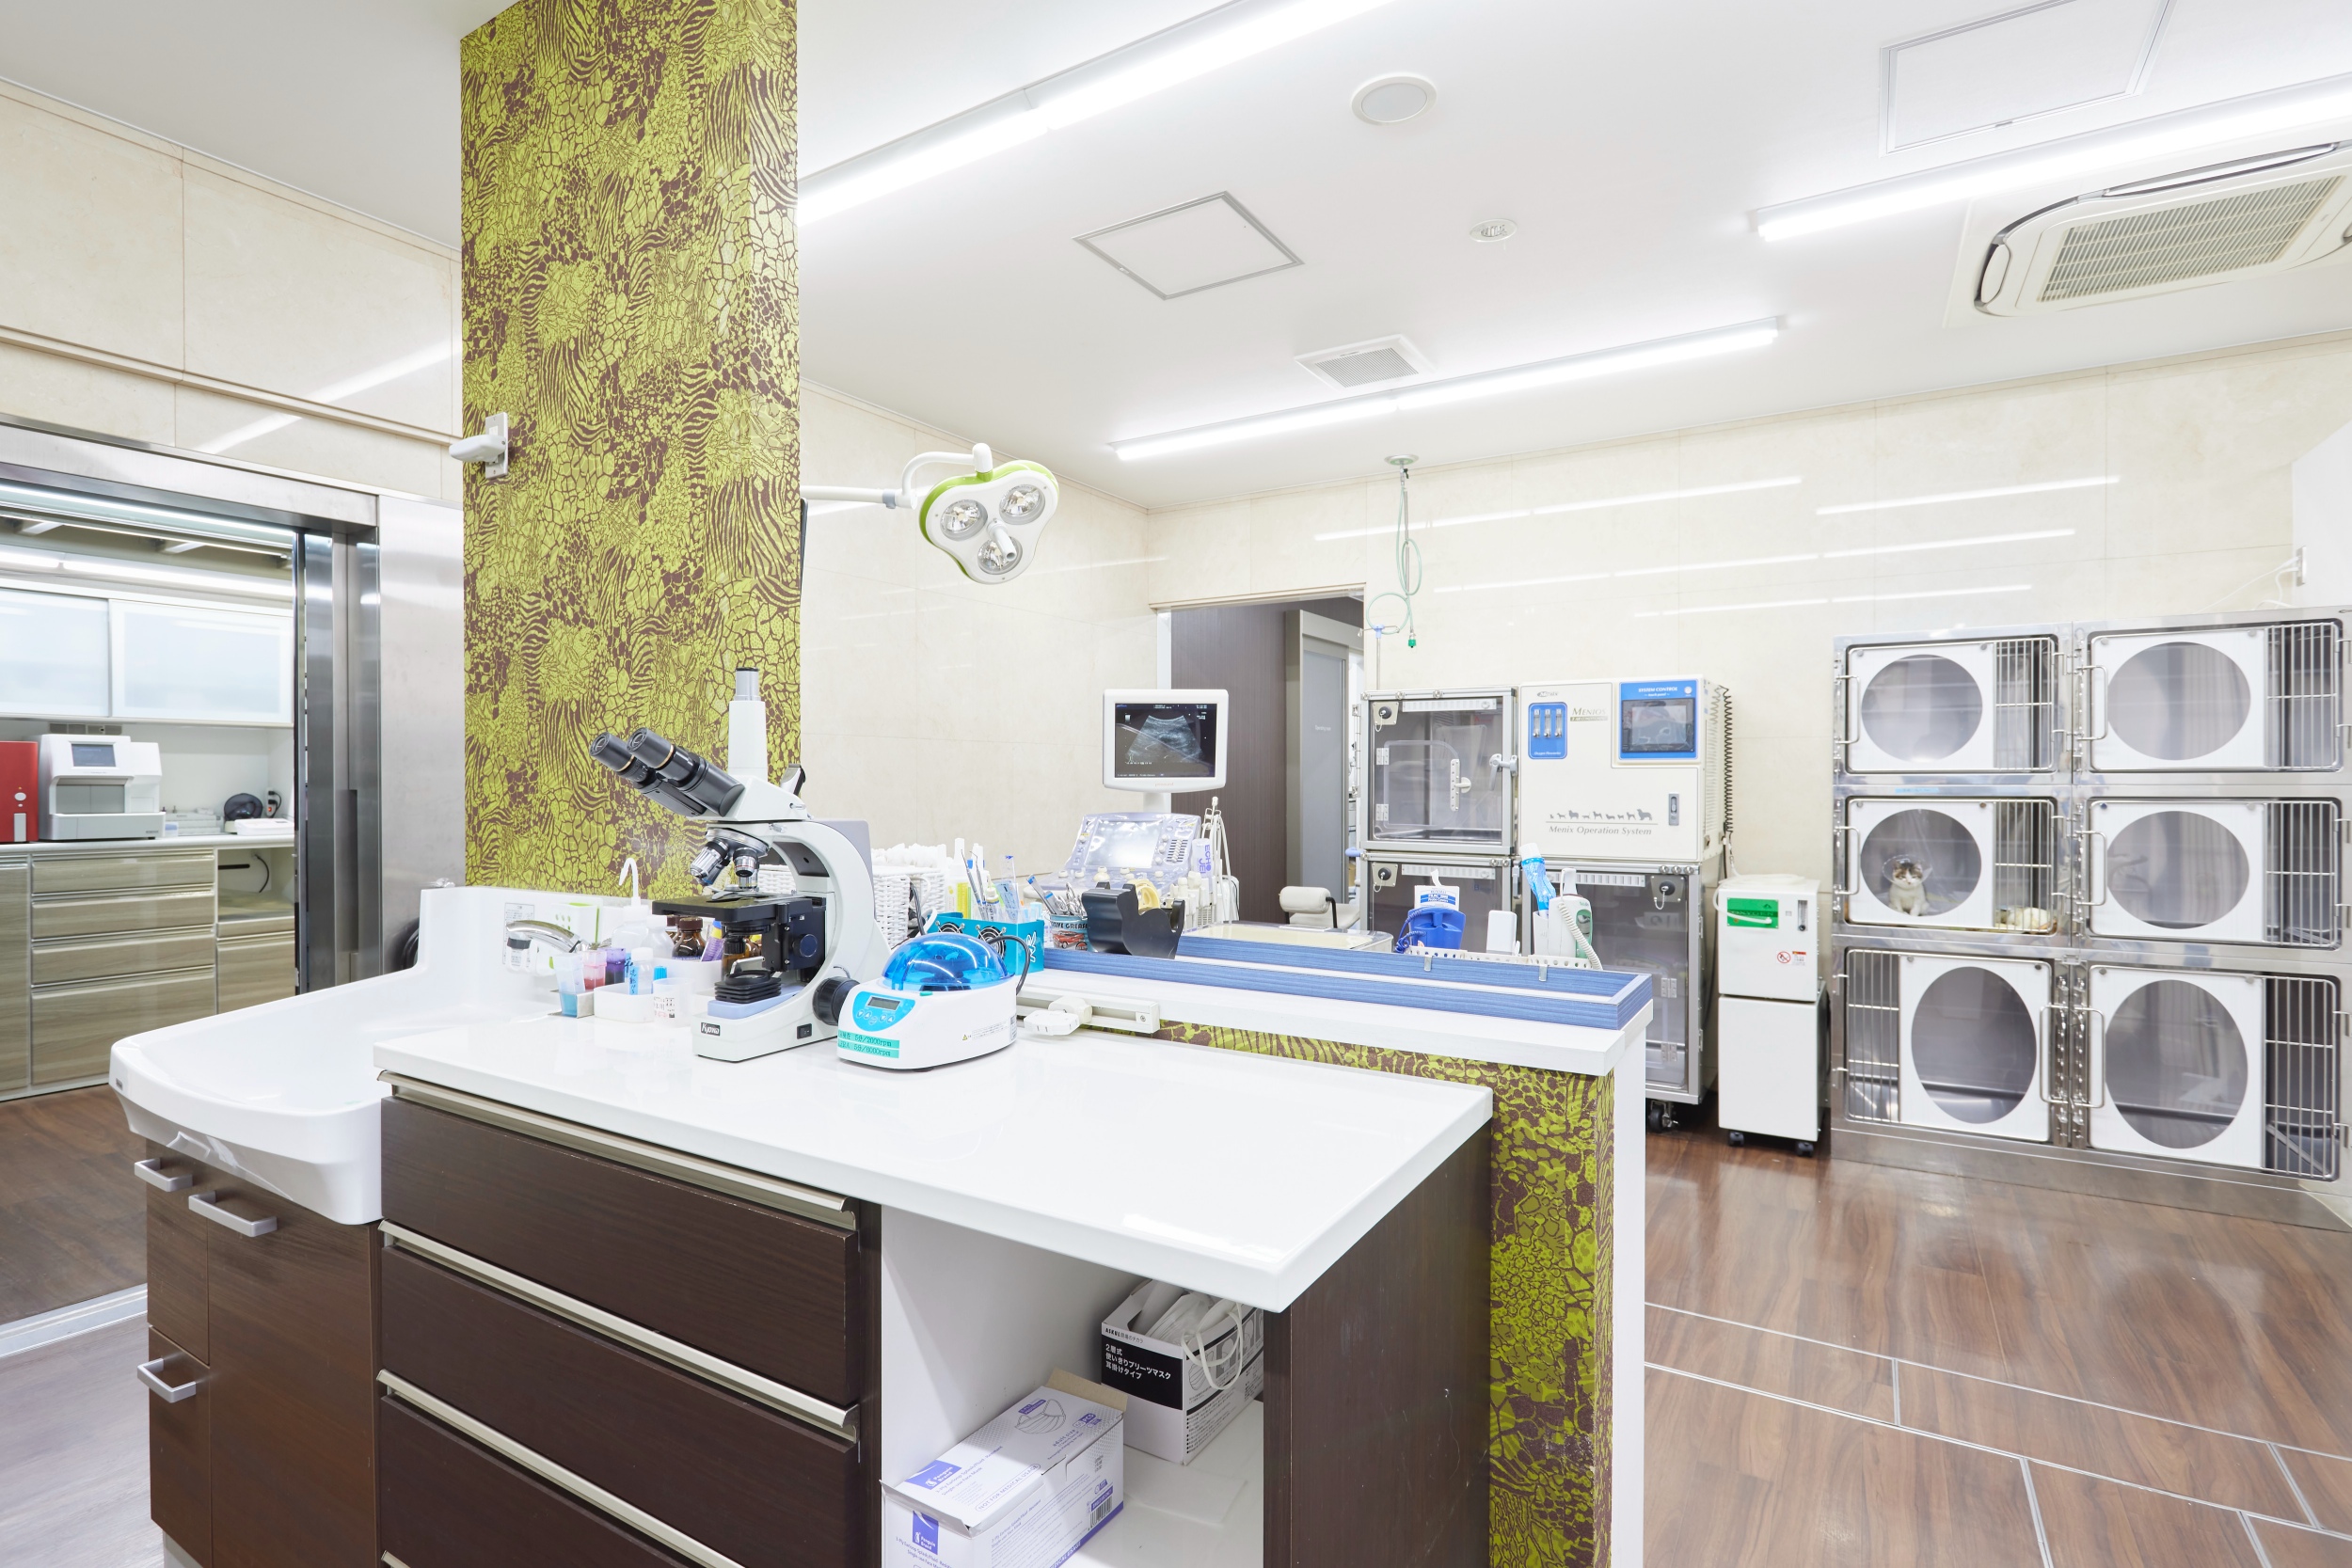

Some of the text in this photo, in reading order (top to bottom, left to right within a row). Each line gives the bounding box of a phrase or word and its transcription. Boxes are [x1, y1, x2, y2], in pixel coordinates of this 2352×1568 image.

[1577, 826, 1619, 835] Operation
[1621, 827, 1652, 836] System
[1105, 1343, 1123, 1356] 2層式
[1105, 1352, 1171, 1380] 使いきりプリーツマスク
[1105, 1360, 1142, 1380] 耳掛けタイプ
[977, 1499, 990, 1511] NOT
[989, 1492, 1001, 1503] FOR
[1000, 1477, 1022, 1494] MEDICAL
[1022, 1465, 1040, 1479] USAGE
[920, 1535, 936, 1547] Penguin
[920, 1541, 932, 1550] Brand
